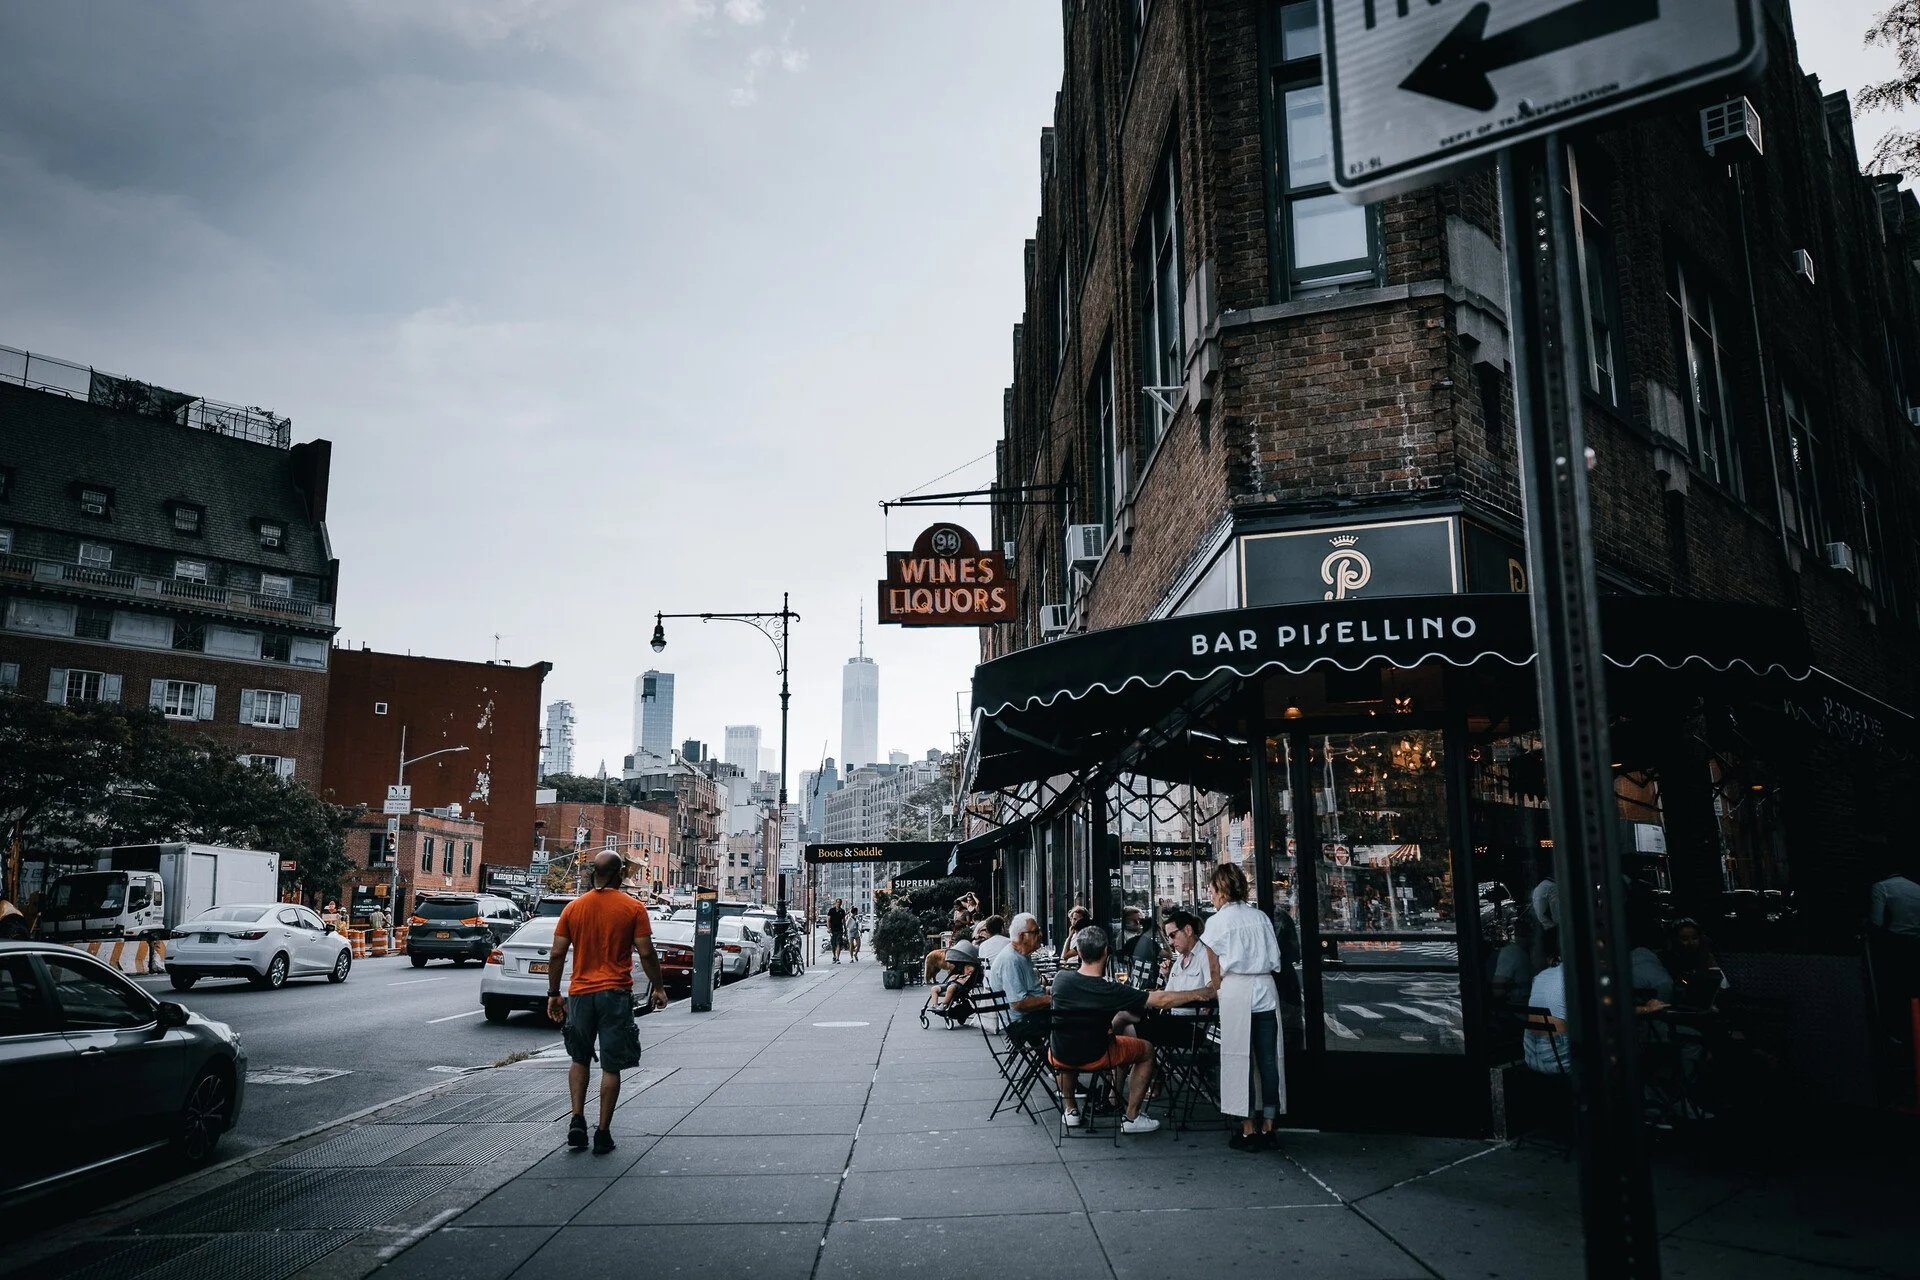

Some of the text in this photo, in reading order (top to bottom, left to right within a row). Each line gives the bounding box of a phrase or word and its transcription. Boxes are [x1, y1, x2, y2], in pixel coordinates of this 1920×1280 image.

[1440, 130, 1472, 147] DEPT
[1477, 123, 1494, 135] OF
[900, 557, 994, 584] WINES
[889, 587, 1007, 615] LIQUORS
[1191, 616, 1477, 655] BAR PISELLINO
[818, 847, 883, 858] Boots & Saddle
[895, 880, 936, 888] SUPREMA
